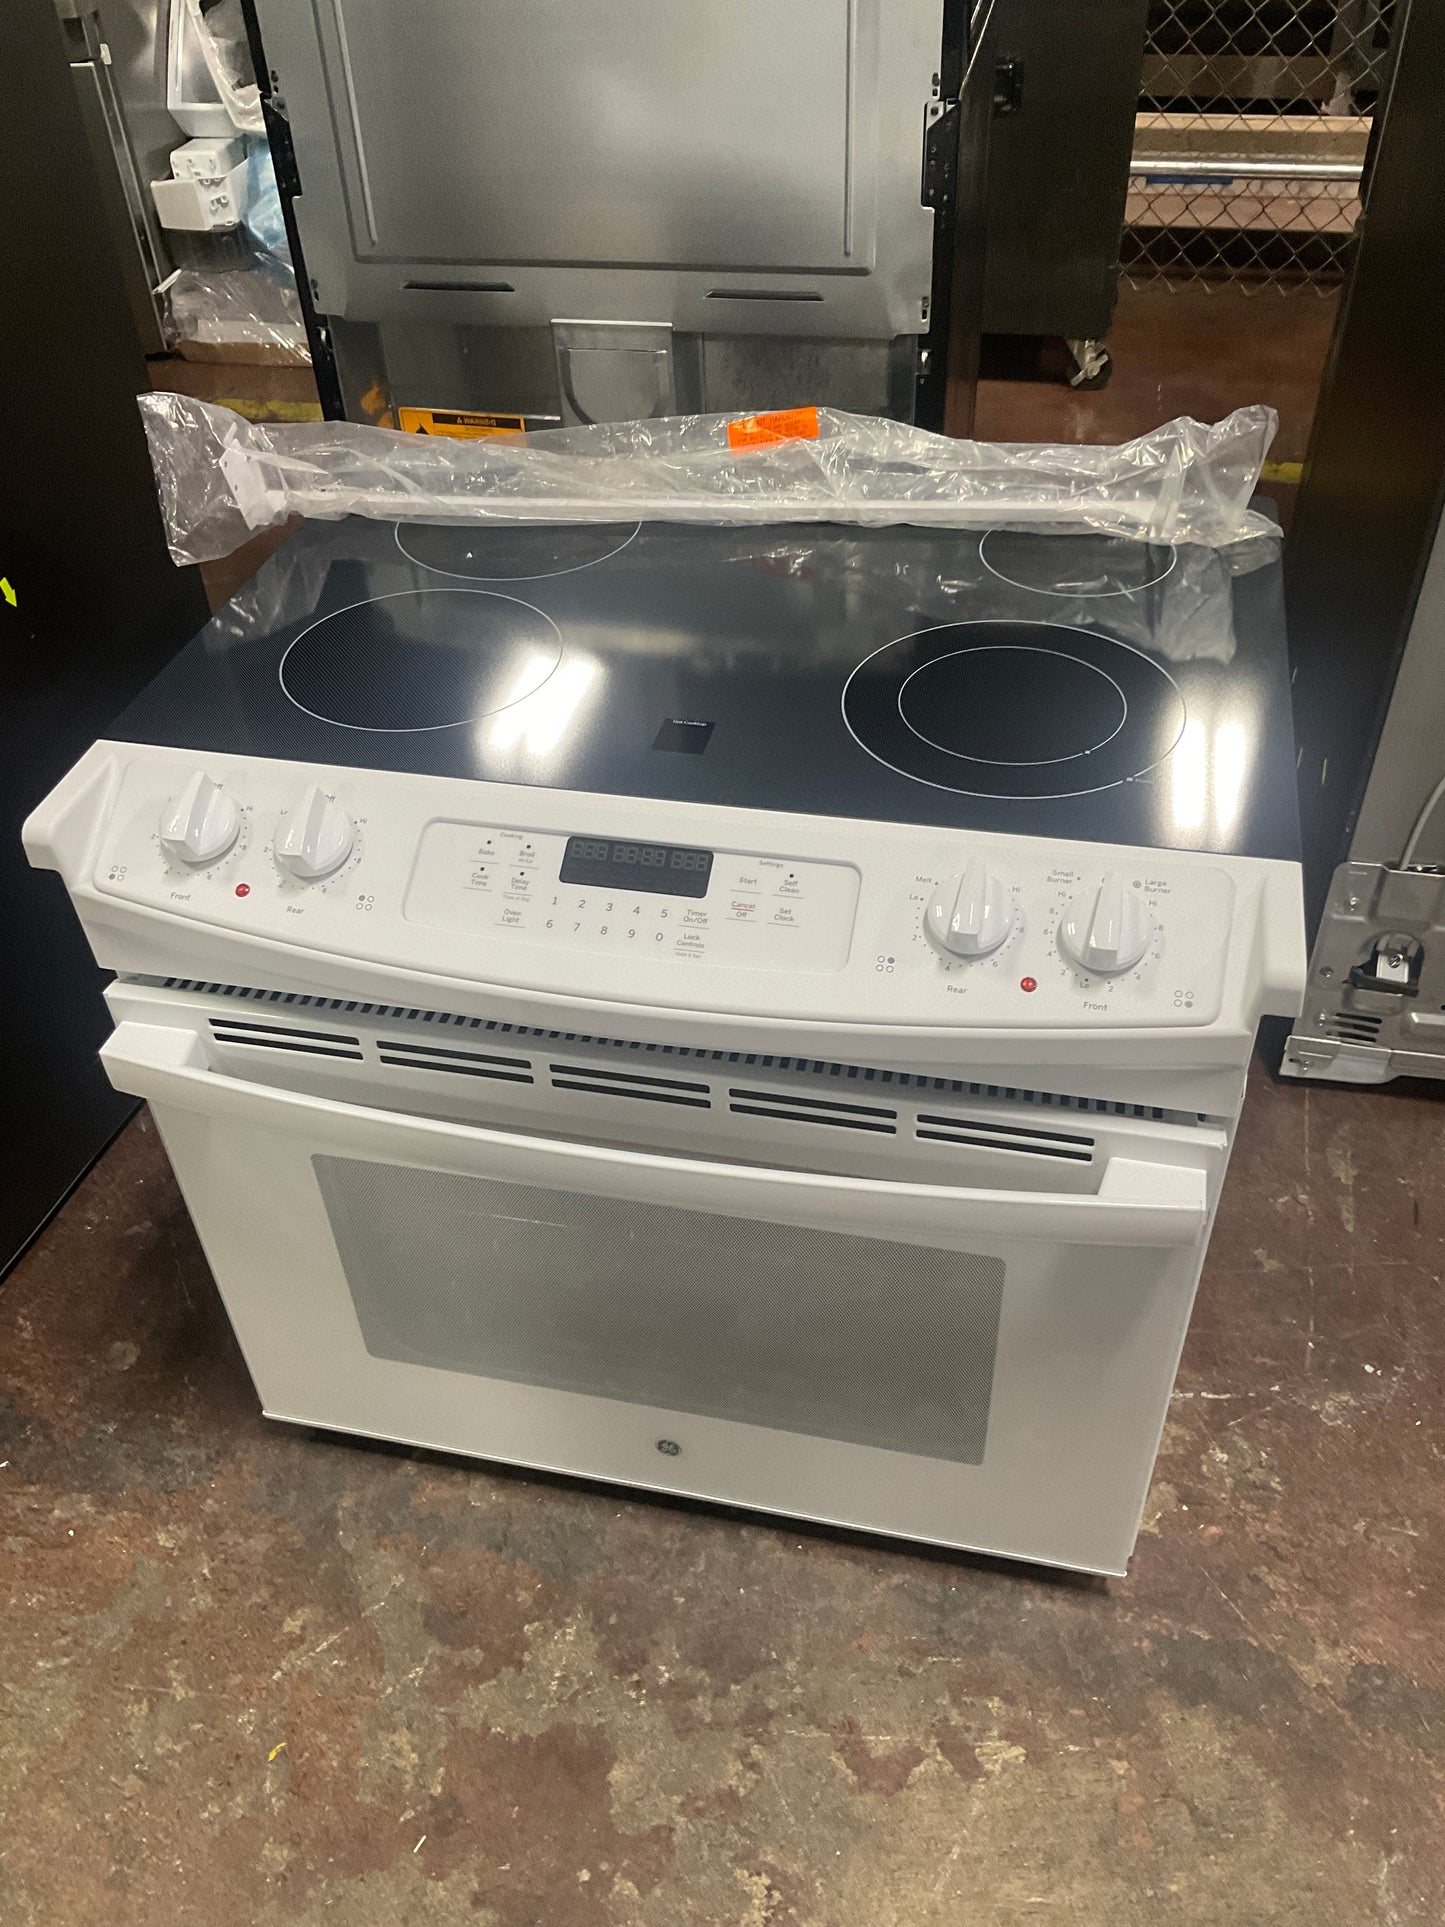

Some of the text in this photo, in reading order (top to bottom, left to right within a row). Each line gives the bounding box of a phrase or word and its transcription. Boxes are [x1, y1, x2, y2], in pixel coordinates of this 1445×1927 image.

[759, 860, 784, 868] Settings
[1052, 870, 1074, 878] Small
[511, 878, 530, 886] Delay
[916, 876, 932, 884] Melt
[1046, 876, 1073, 884] Burner
[1145, 879, 1168, 887] Large
[779, 886, 800, 894] Clean
[1144, 886, 1172, 894] Burner
[170, 892, 191, 901] Front
[552, 896, 668, 918] 1 2 3 4 5
[732, 901, 756, 909] Cancel
[286, 906, 304, 914] Rear
[687, 909, 708, 917] Timer
[683, 916, 708, 924] On/Off
[774, 914, 794, 922] Clock
[546, 920, 664, 942] 6 7 8 9 0
[676, 940, 704, 948] Controls
[947, 985, 968, 994] Rear
[1083, 1002, 1108, 1011] Front
